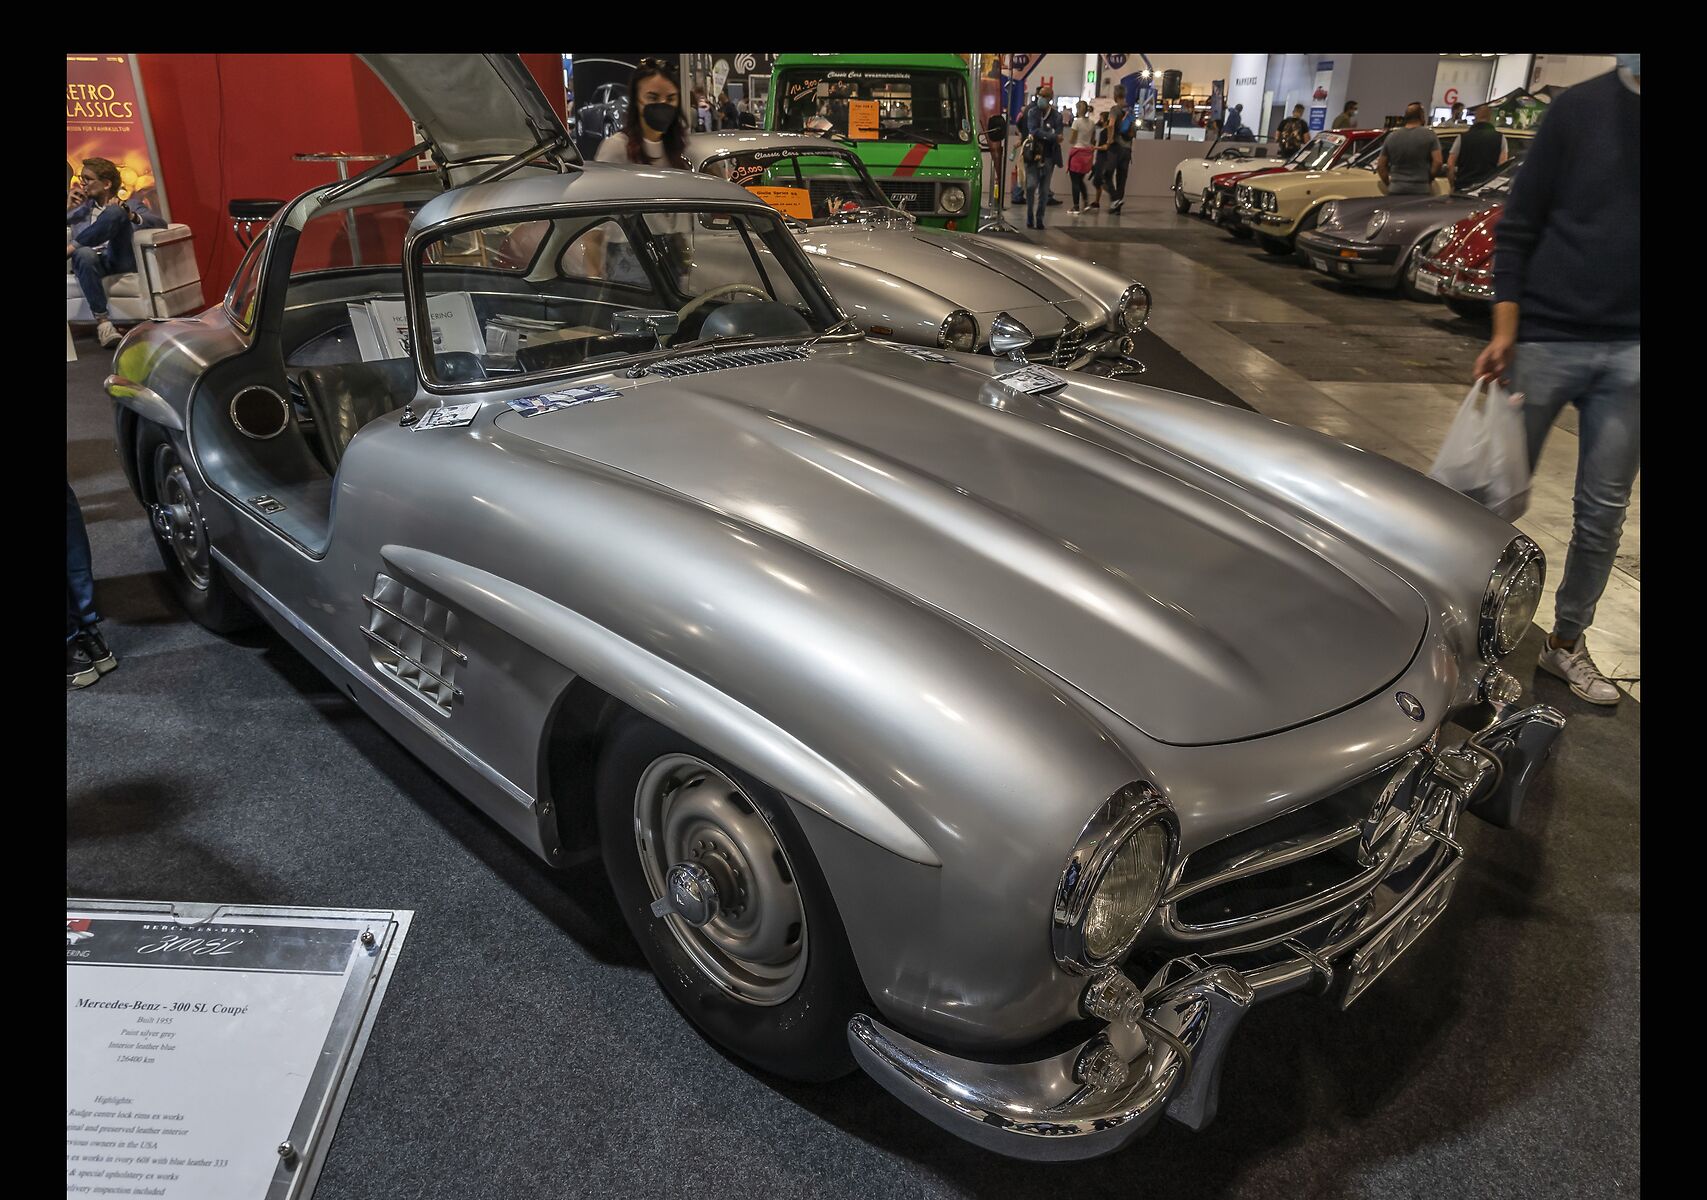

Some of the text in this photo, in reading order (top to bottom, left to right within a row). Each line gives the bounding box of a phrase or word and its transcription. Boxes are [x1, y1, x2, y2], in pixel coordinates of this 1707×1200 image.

[1444, 88, 1458, 106] G
[67, 101, 133, 118] LASSICS
[891, 193, 917, 202] FIAT
[75, 998, 161, 1011] Mercedes-Benz
[169, 1002, 191, 1012] 300
[192, 1002, 209, 1014] SL
[212, 1003, 249, 1016] Coupé
[136, 1016, 155, 1024] Built
